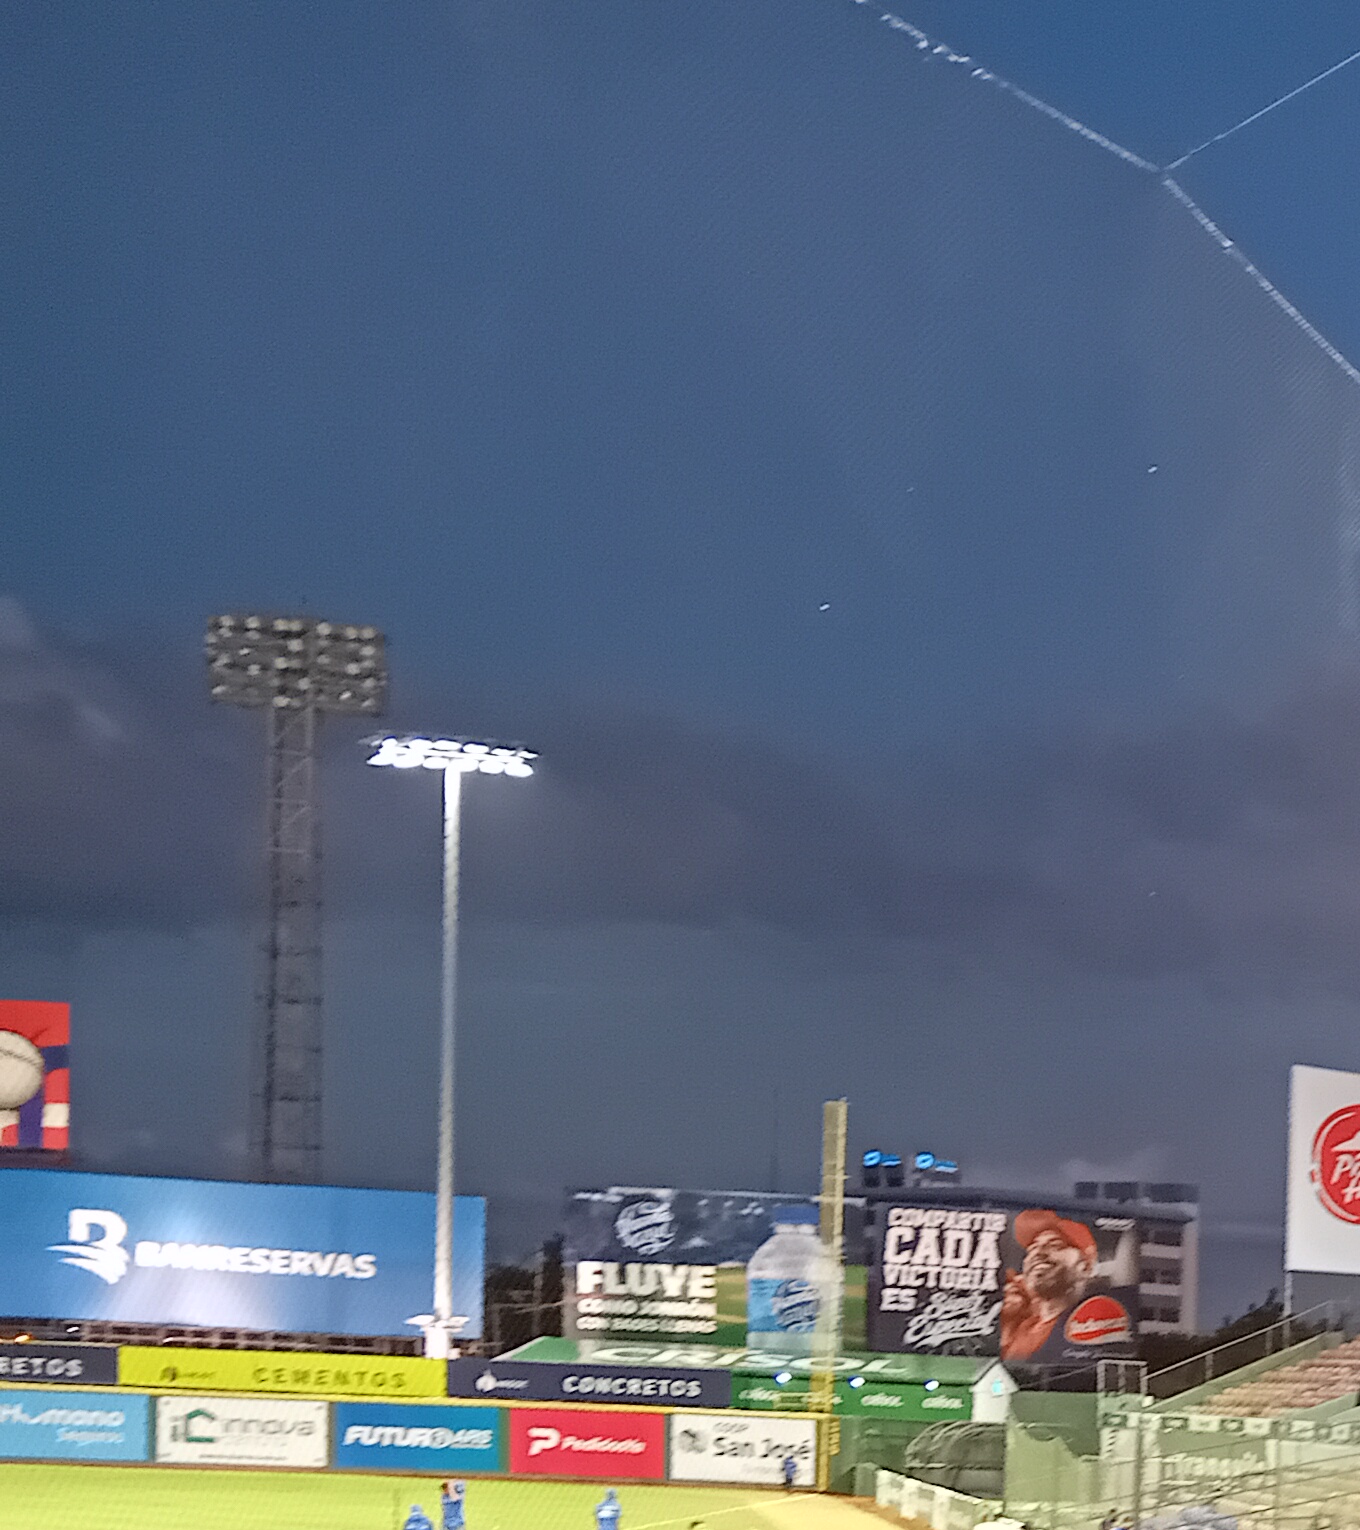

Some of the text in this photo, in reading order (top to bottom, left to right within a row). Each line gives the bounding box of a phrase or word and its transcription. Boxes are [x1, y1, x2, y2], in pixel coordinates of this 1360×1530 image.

[883, 1227, 1001, 1269] CADA
[576, 1261, 717, 1298] FLUYE
[883, 1264, 999, 1291] VICTORIA
[879, 1288, 918, 1312] ES
[590, 1347, 907, 1374] CRISOL
[252, 1367, 406, 1389] CEMENTOS
[561, 1375, 701, 1398] CONCRETOS
[712, 1437, 755, 1458] San
